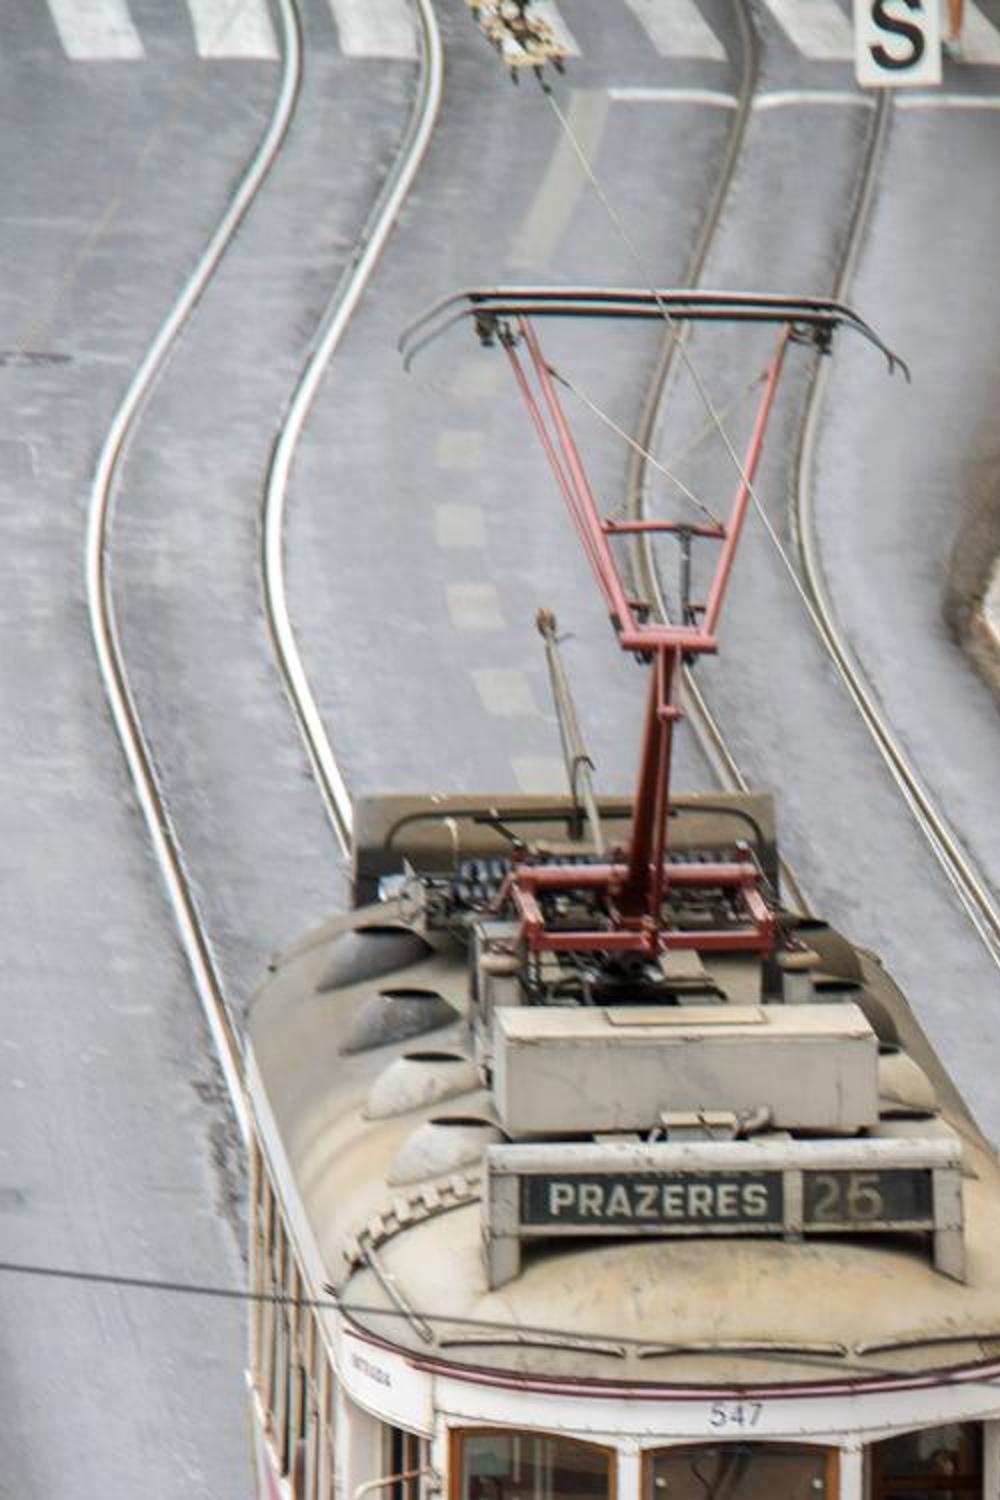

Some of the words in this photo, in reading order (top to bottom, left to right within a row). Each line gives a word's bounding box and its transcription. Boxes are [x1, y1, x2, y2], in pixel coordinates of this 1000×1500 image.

[869, 0, 925, 71] S
[549, 1182, 769, 1218] PRAZERES
[710, 1402, 763, 1427] 547
